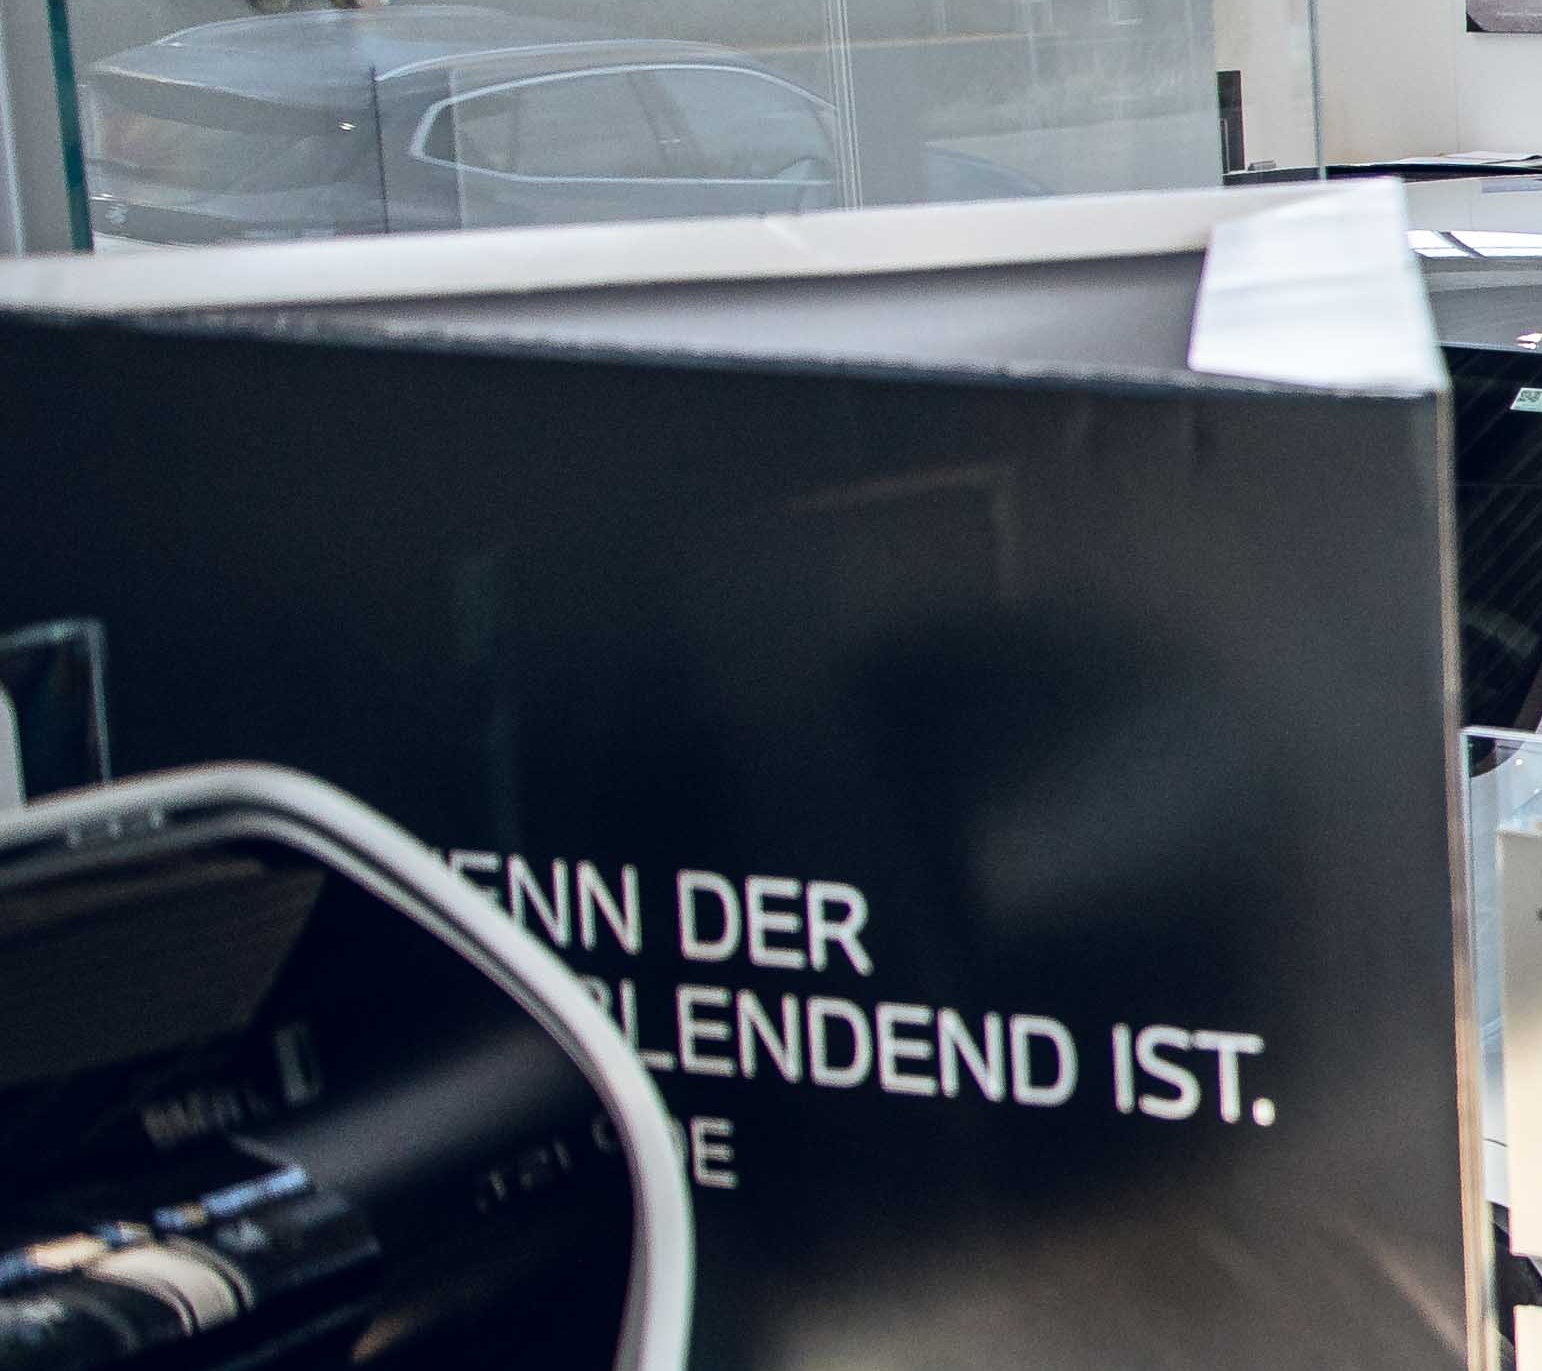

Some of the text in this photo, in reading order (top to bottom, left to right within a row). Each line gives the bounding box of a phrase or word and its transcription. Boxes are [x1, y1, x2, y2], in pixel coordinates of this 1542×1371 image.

[440, 847, 873, 976] ENN DER
[1110, 1020, 1278, 1127] IST.
